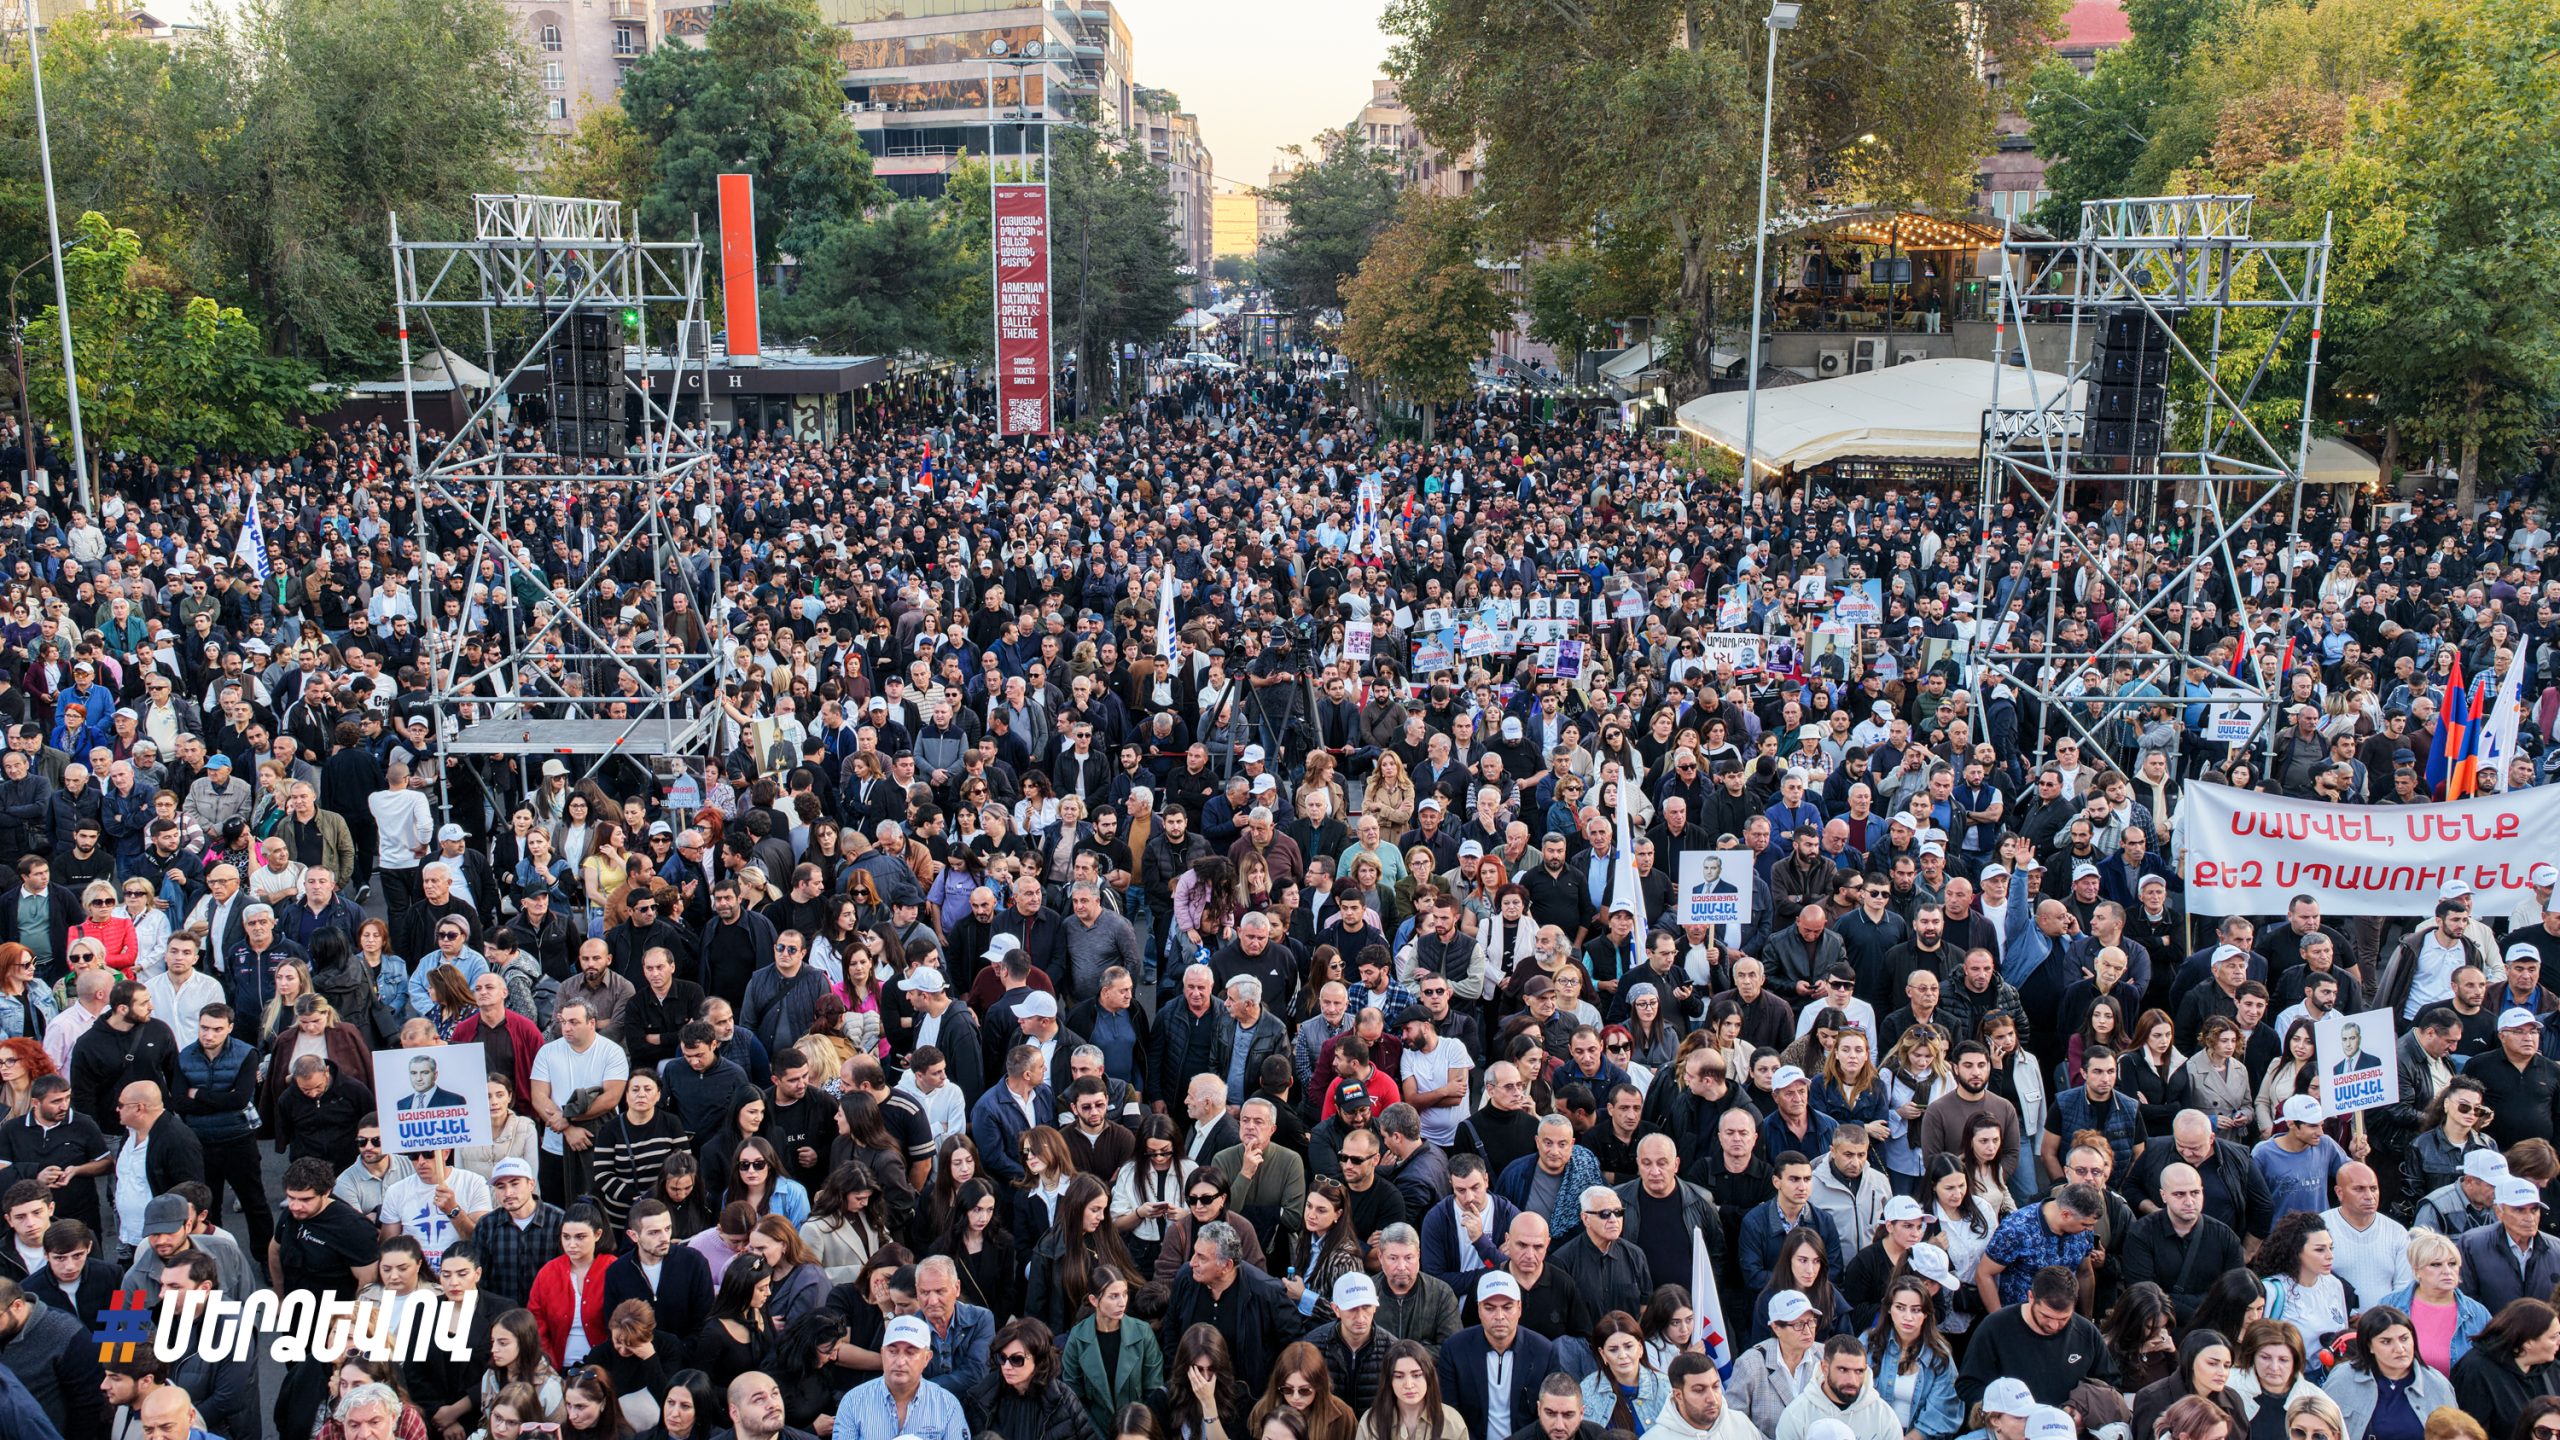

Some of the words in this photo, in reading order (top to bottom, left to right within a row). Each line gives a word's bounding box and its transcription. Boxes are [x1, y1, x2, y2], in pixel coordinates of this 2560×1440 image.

[1002, 282, 1044, 293] ARMENIAN
[1002, 294, 1041, 305] NATIONAL
[1002, 305, 1028, 316] OPERA
[1031, 306, 1040, 316] &
[1002, 317, 1032, 327] BALLET
[1002, 328, 1039, 339] THEATRE
[1014, 367, 1036, 375] TICKETS
[1014, 377, 1035, 385] БИЛЕТЫ
[2231, 811, 2394, 847] ՍԱՄՎԵԼ,
[2407, 812, 2519, 842] ՄԵՆՔ
[2192, 860, 2263, 889] ՔԵԶ
[2276, 862, 2465, 891] ՍՊԱՍՈՒՄ
[1691, 903, 1738, 914] ՍԱՄՎԵԼ
[2334, 1080, 2384, 1102] ՍԱՄՎԵԼ
[398, 1109, 469, 1122] ԱԶԱՏՈՒԹՅՈՒՆ
[399, 1118, 470, 1138] ՍԱՄՎԵԼ
[401, 1135, 472, 1148] ԿԱՐԱՊԵՏՅԱՆԻՆ
